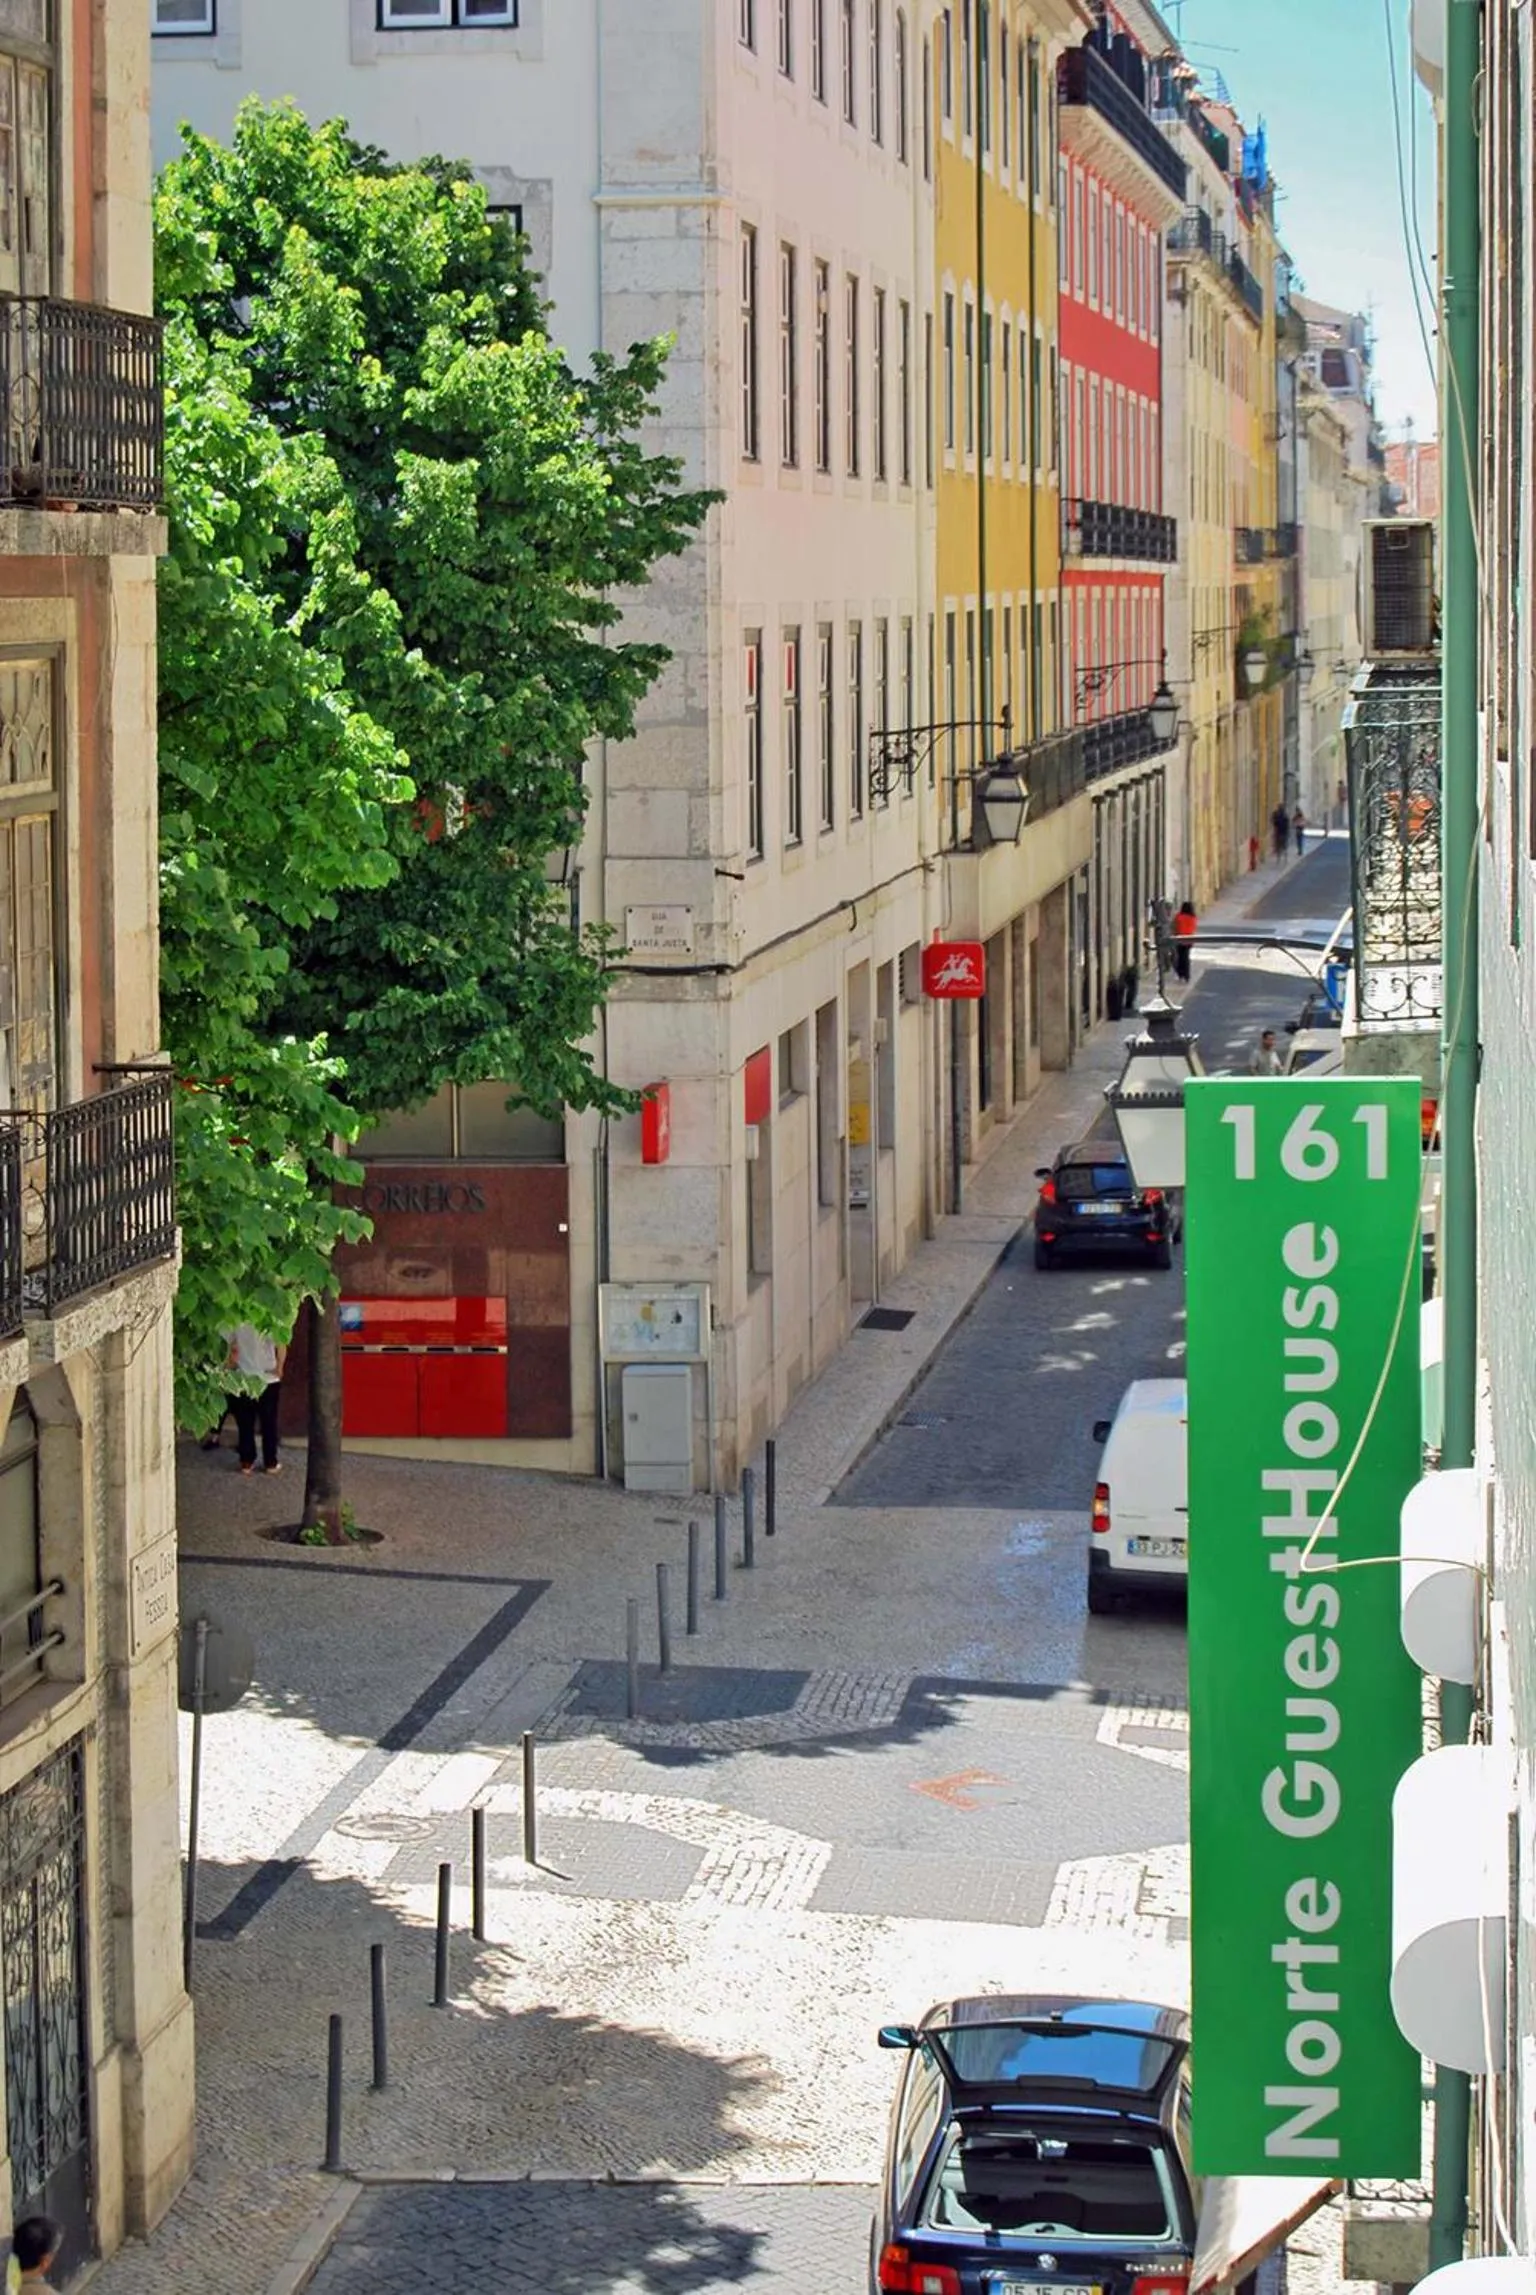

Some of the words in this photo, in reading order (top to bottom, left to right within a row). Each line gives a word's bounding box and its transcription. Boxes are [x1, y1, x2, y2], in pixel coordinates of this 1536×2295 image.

[632, 938, 659, 947] SANTA
[1219, 1104, 1388, 1181] 161
[1264, 1876, 1342, 2160] Norte
